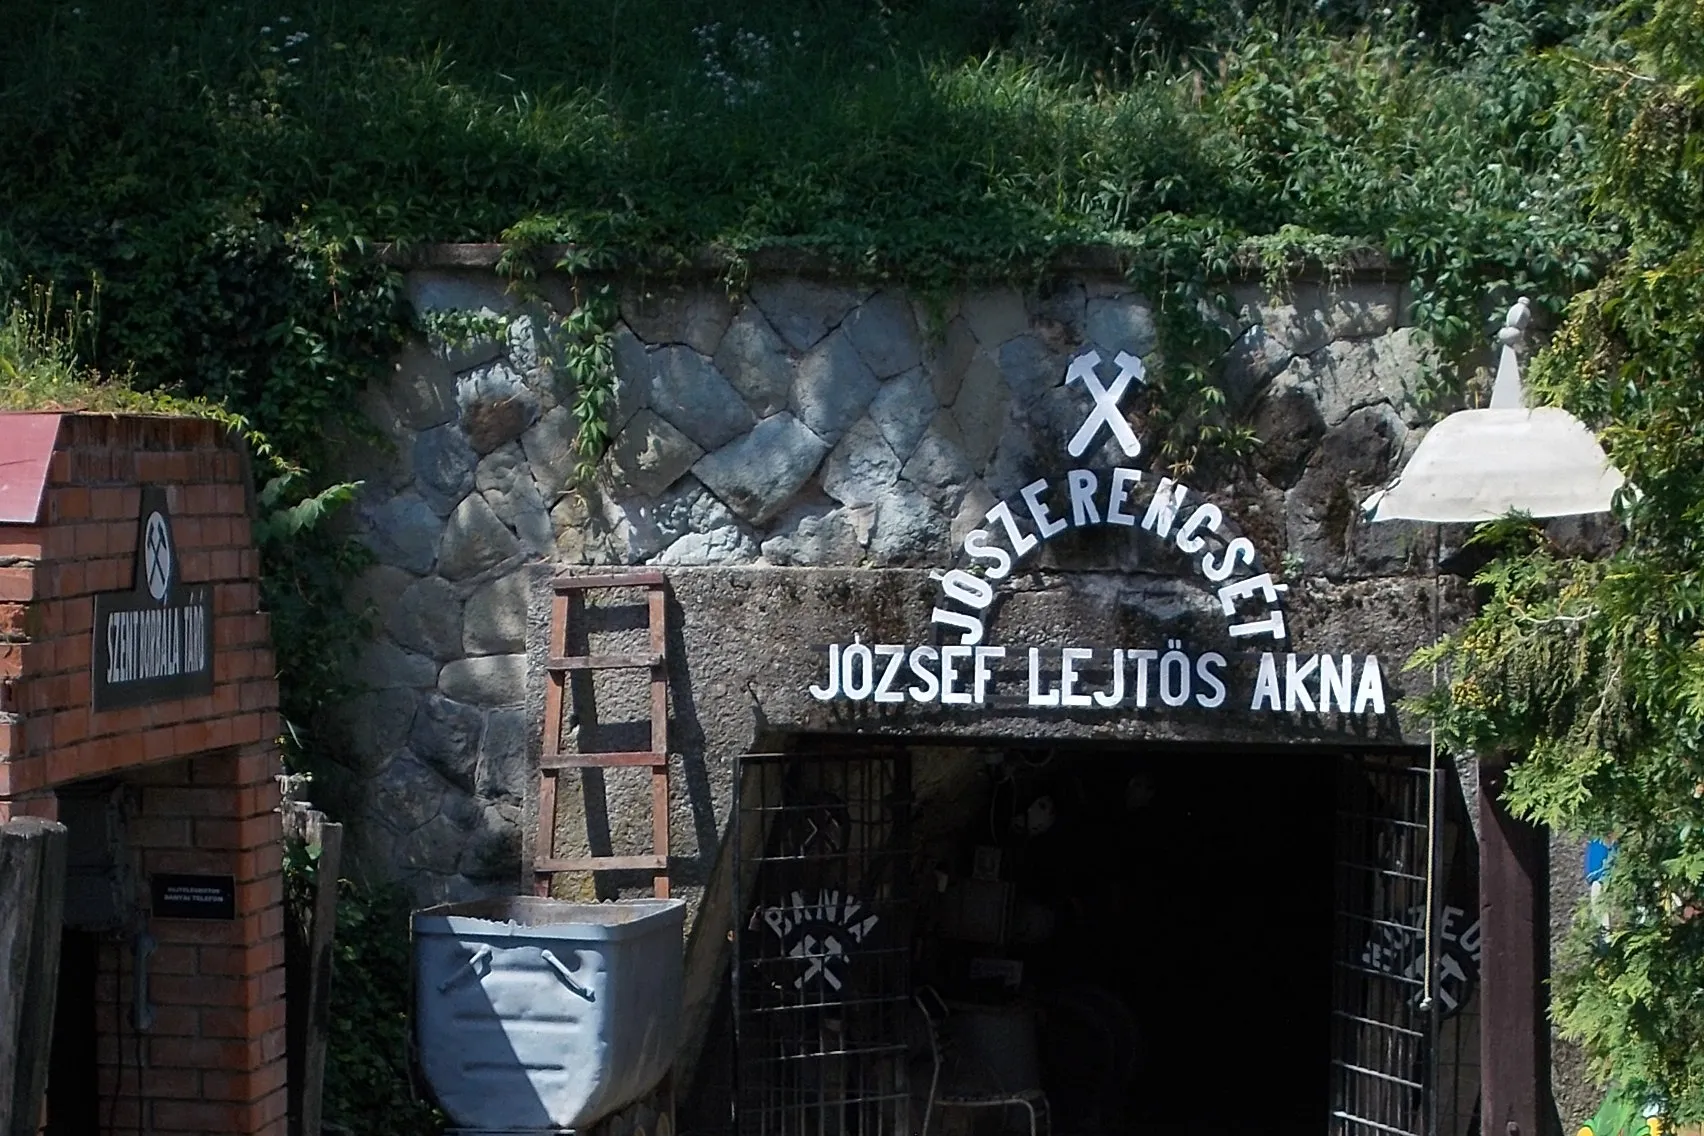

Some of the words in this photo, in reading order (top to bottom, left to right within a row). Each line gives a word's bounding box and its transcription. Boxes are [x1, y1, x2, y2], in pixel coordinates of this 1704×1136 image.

[107, 611, 139, 684] SZENT
[808, 632, 1007, 705] JÓZSEF
[1026, 638, 1228, 708] LEJTÖS
[1250, 651, 1387, 716] AKNA
